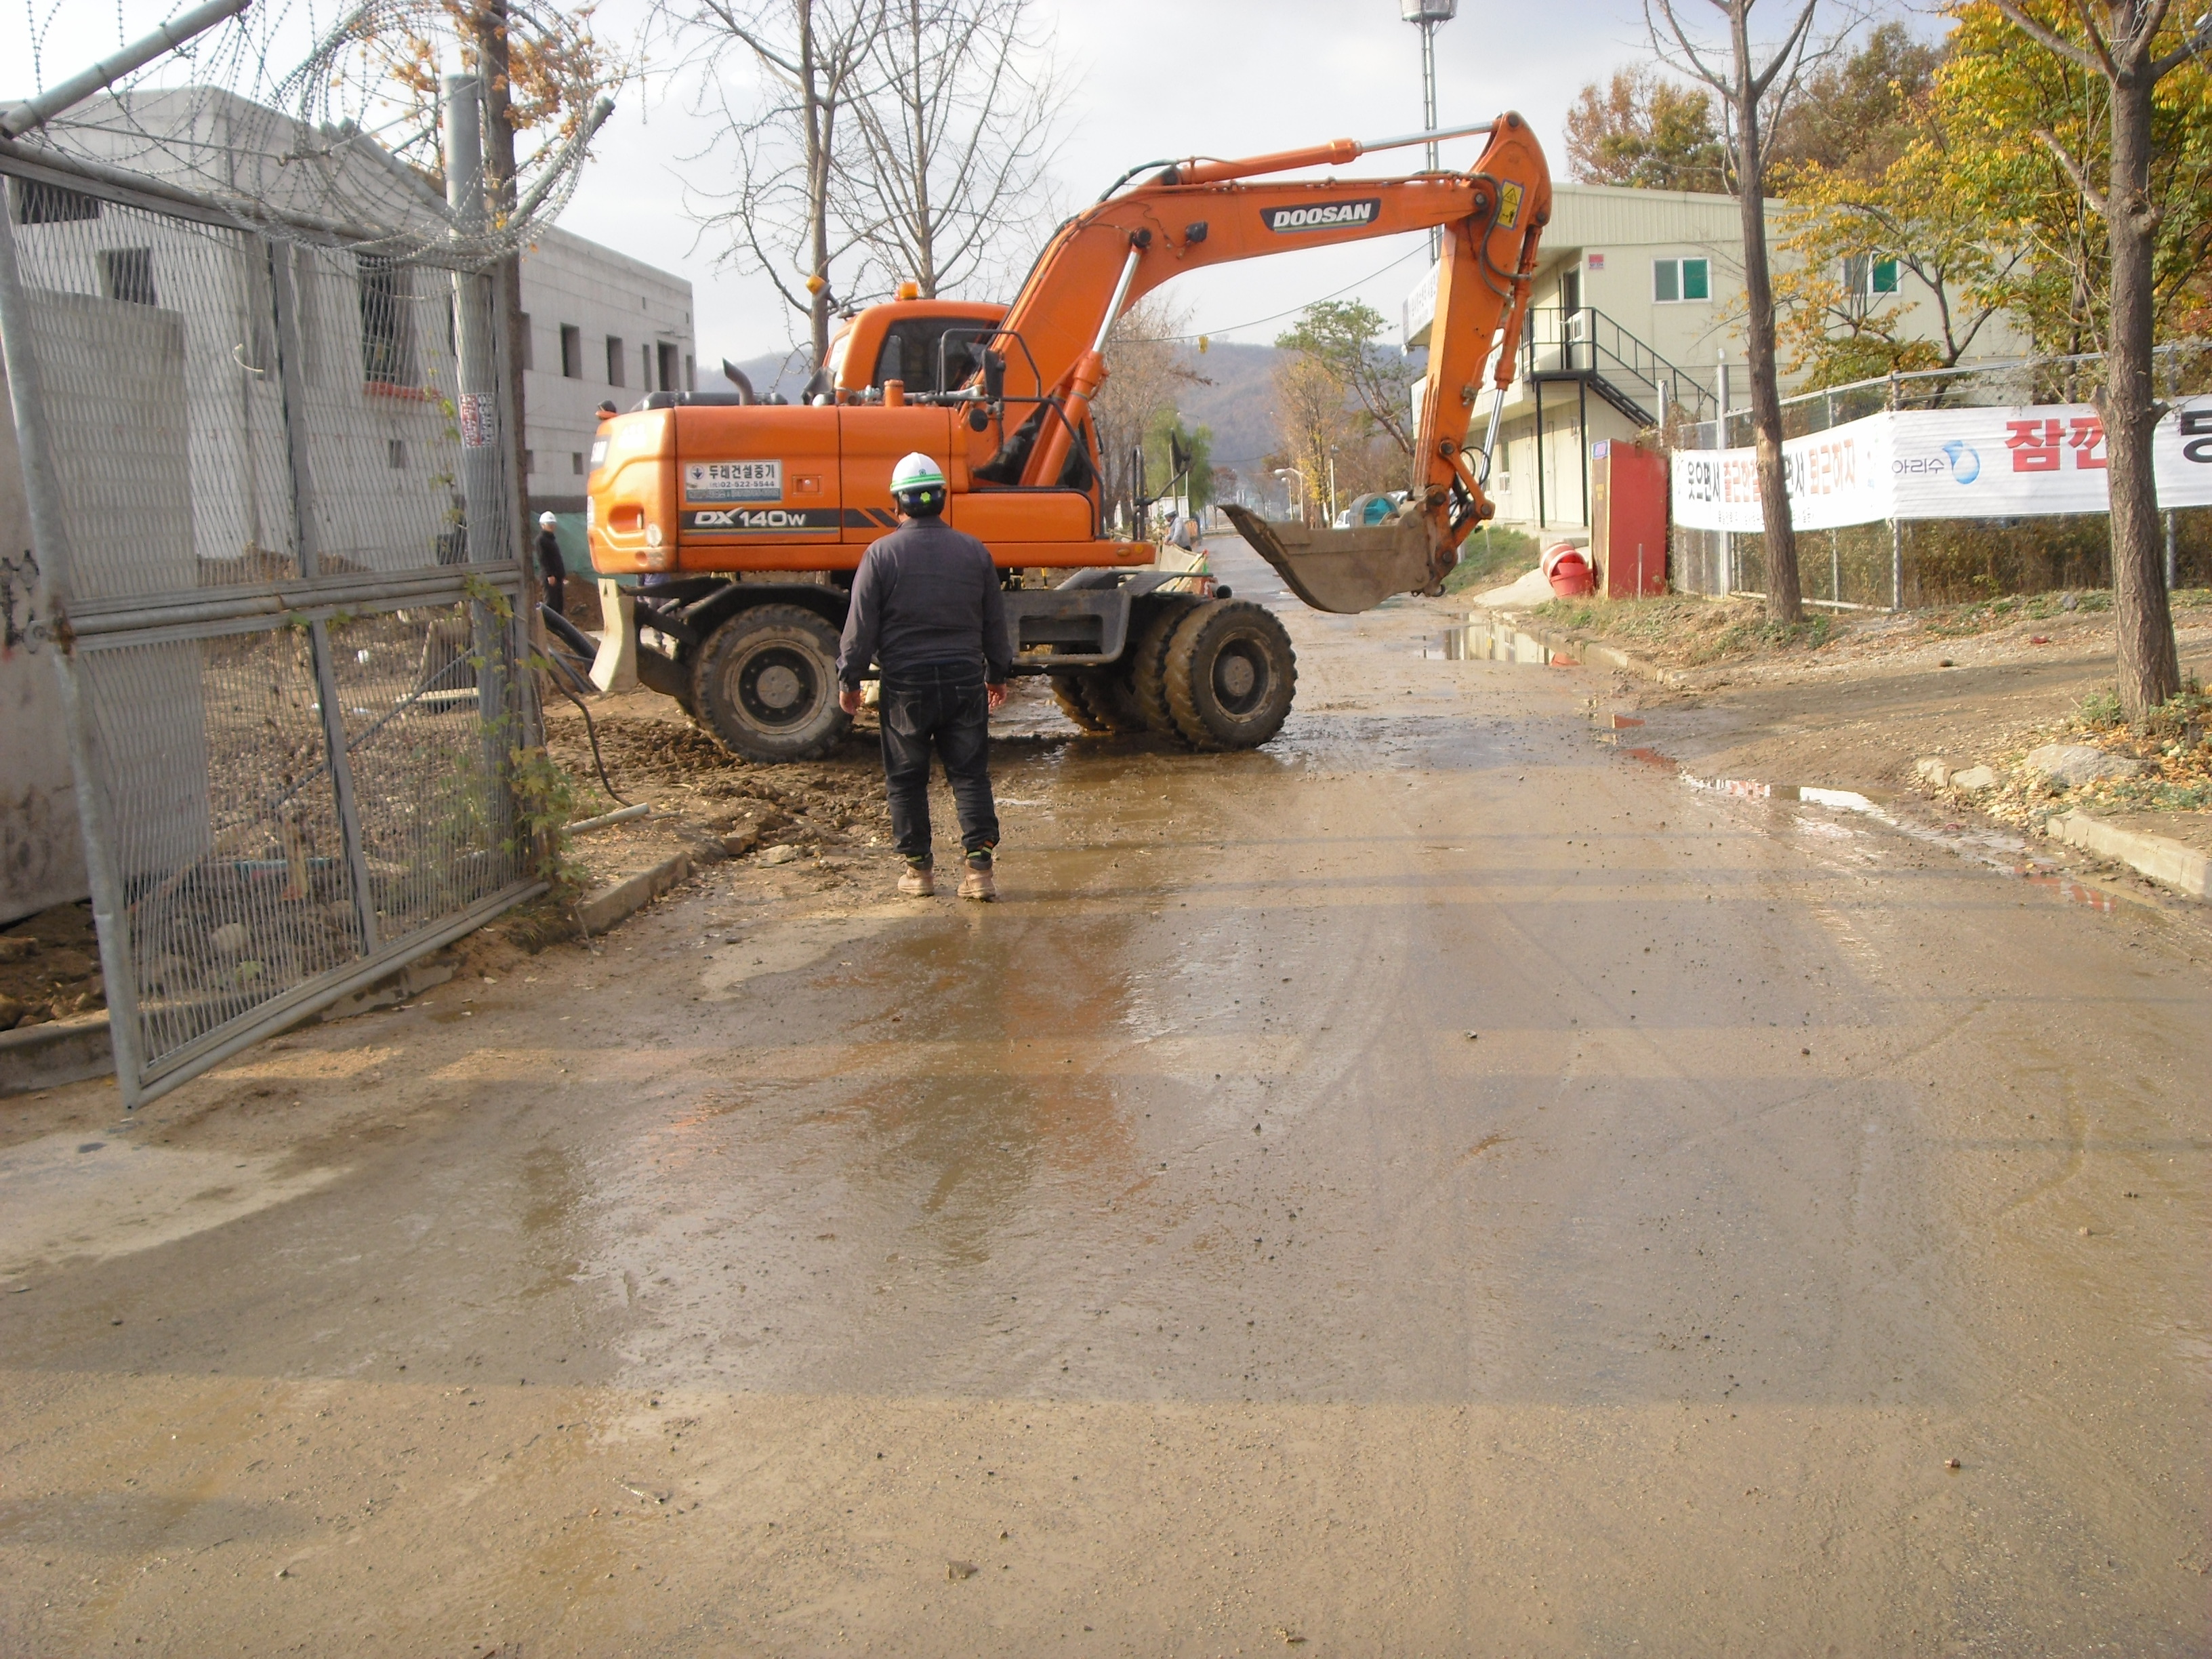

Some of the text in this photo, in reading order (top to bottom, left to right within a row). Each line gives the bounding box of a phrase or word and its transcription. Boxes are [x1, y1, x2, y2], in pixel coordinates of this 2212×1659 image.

[1273, 203, 1372, 227] DOOSAN
[709, 464, 775, 479] 두레건설중기
[1891, 458, 1945, 474] 아리수
[1687, 461, 1721, 502] 웃으면서
